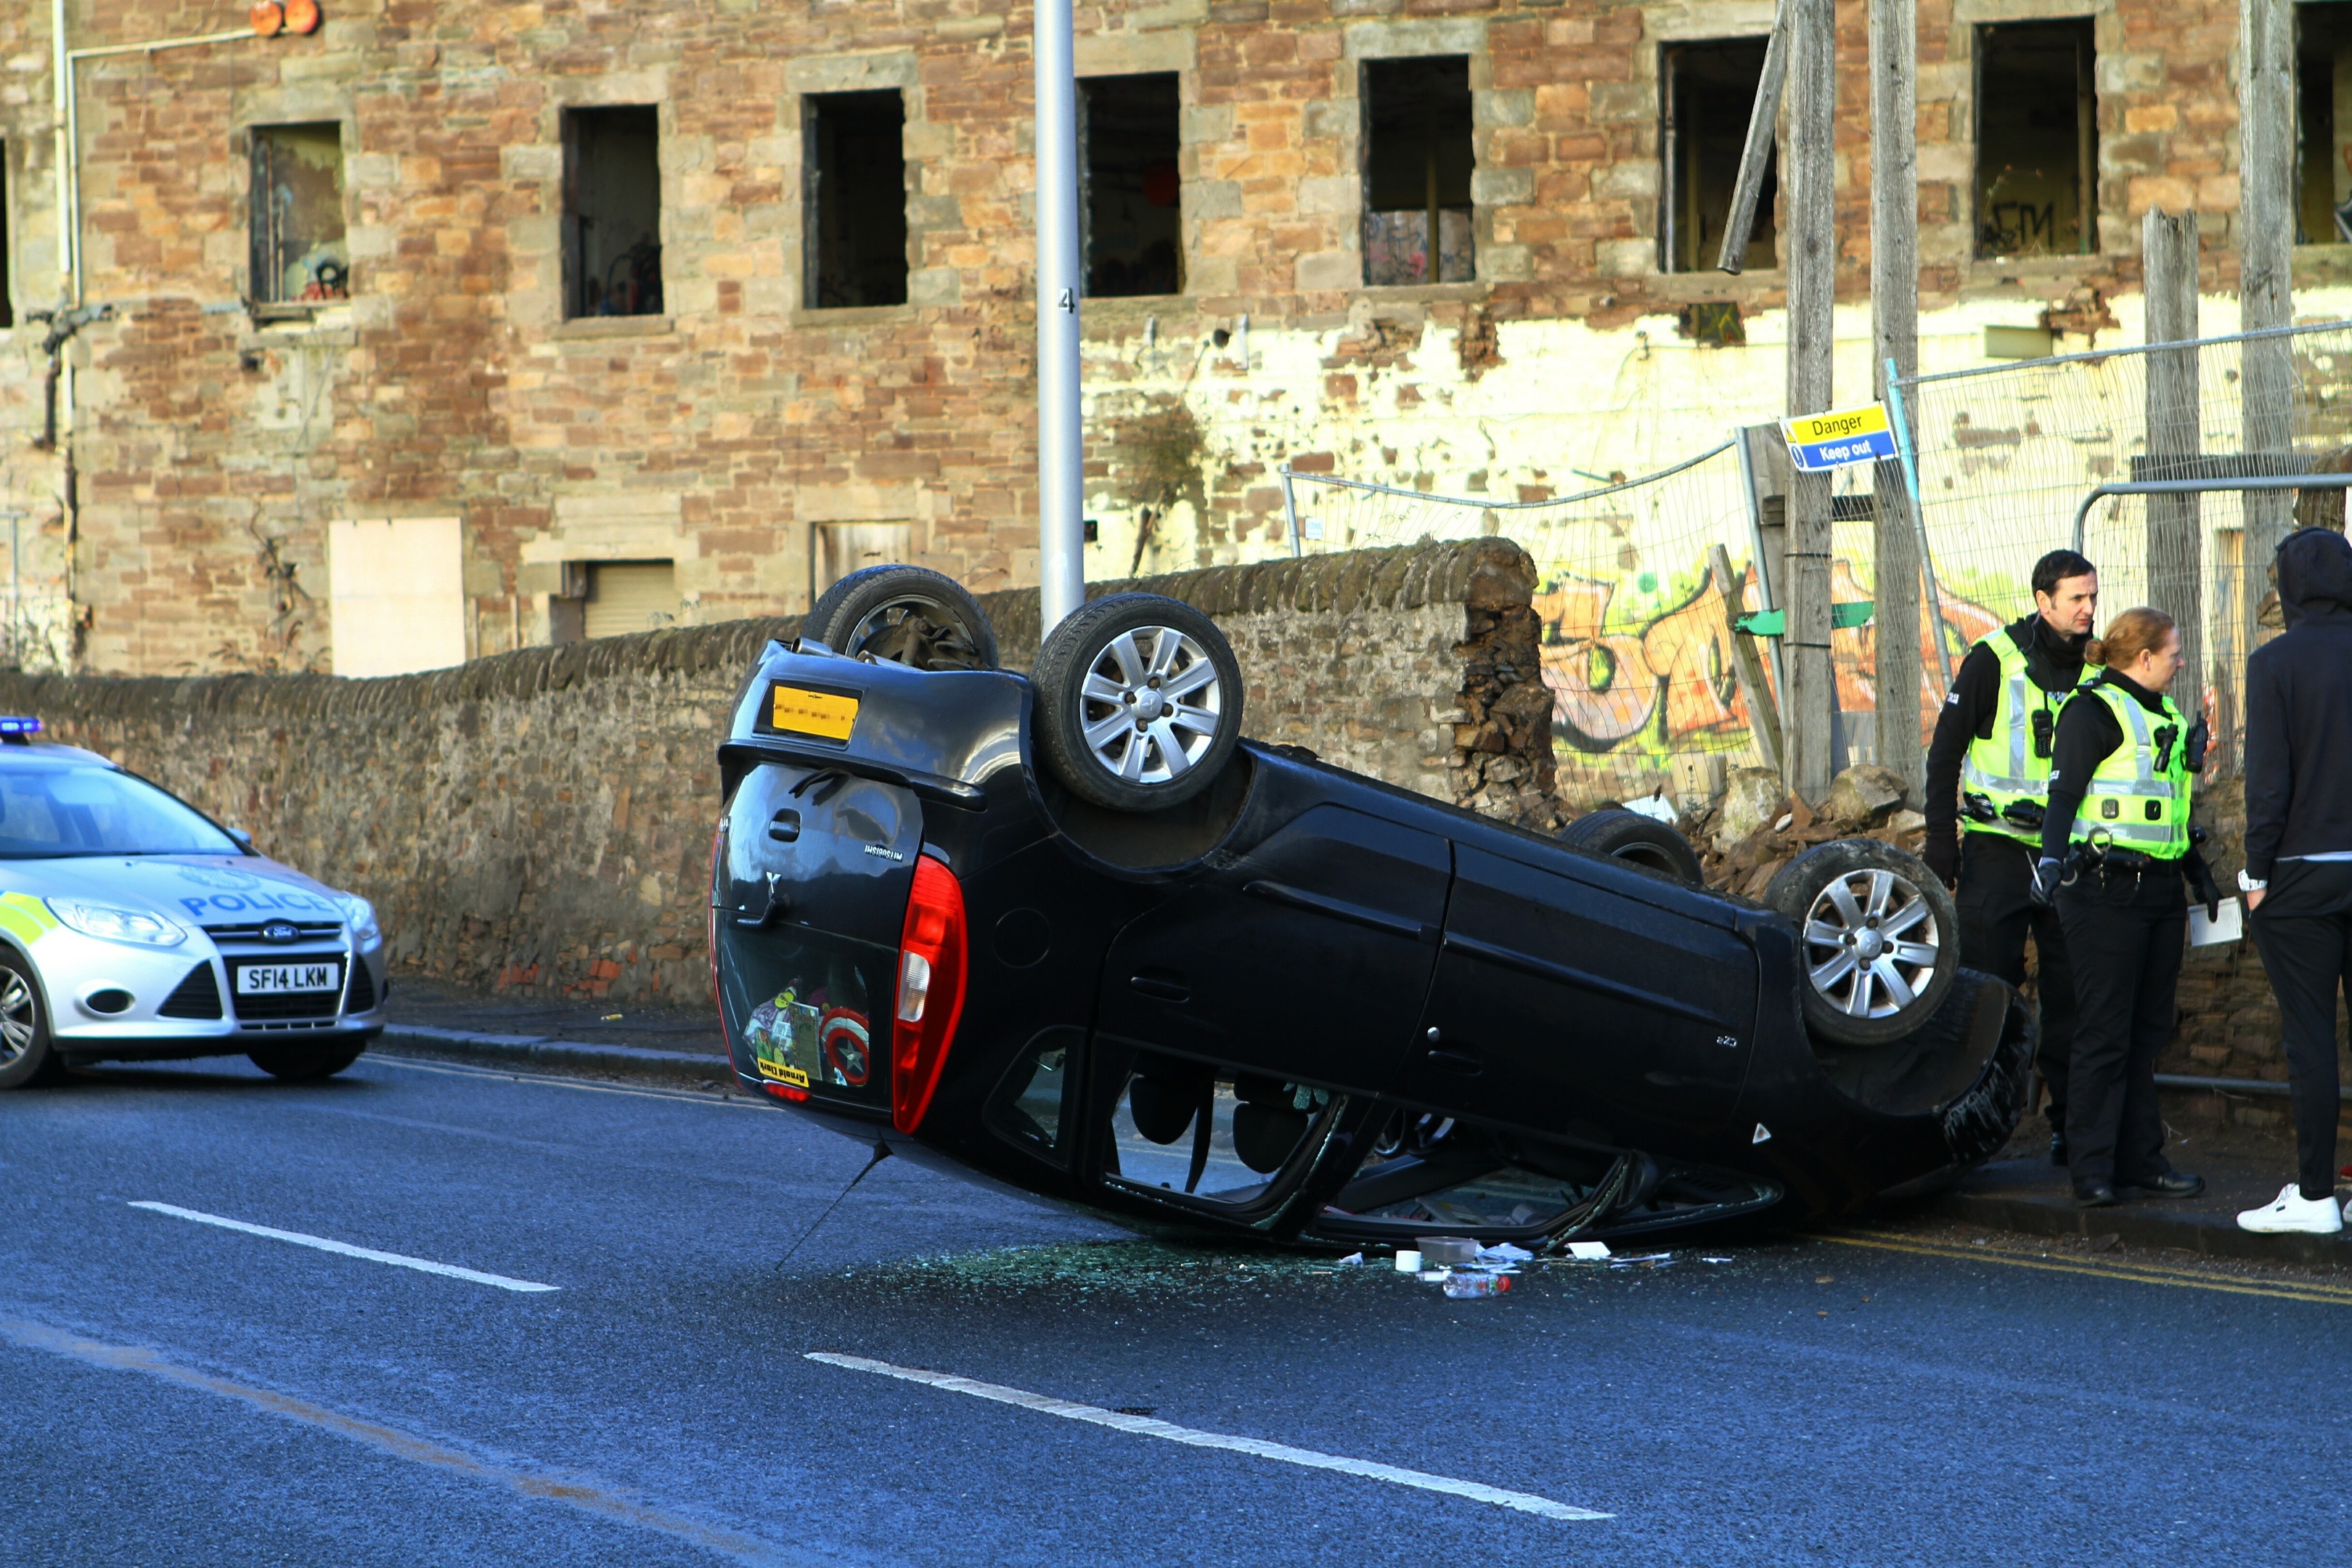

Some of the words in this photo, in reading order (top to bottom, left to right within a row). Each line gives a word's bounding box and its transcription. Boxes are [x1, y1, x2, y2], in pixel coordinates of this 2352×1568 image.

[1058, 287, 1075, 314] 4
[1812, 416, 1861, 436] Danger
[1819, 446, 1850, 461] Keep
[1851, 439, 1871, 455] out
[864, 844, 903, 861] MITSUBISHI
[179, 893, 336, 917] POLICE
[249, 968, 289, 989] SF14
[294, 966, 327, 987] LKM
[759, 1061, 777, 1076] Clark
[778, 1068, 805, 1084] Arnold
